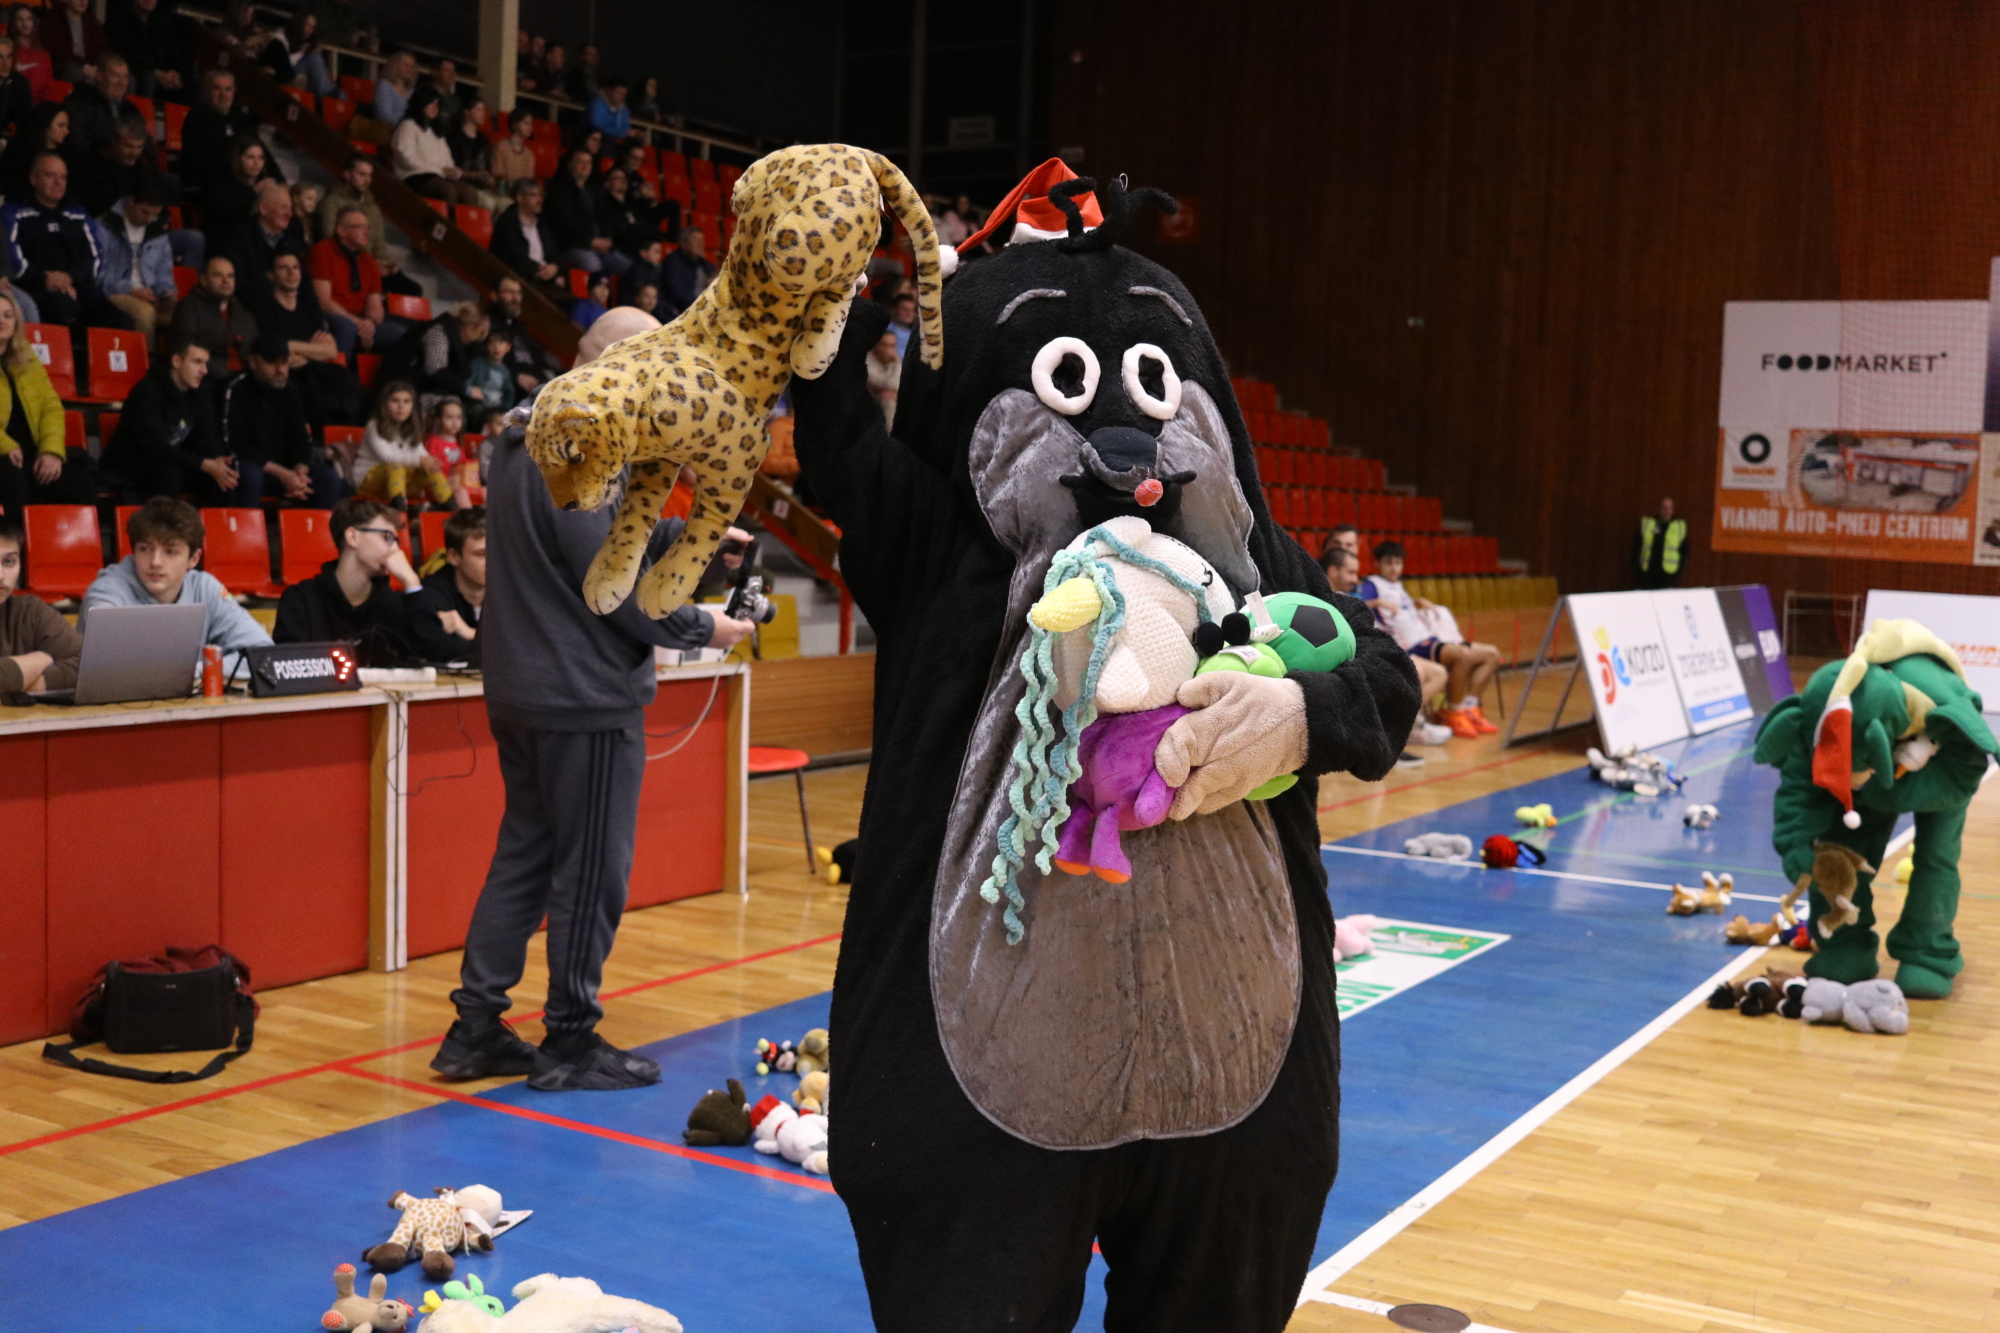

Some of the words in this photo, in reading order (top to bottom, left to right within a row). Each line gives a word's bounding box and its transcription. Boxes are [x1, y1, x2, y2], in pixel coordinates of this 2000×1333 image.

[1761, 353, 1938, 373] FOODMARKET
[1784, 510, 1881, 537] AUTO-PNEU
[1885, 515, 1970, 541] CENTRUM
[273, 657, 336, 680] POSSESSION
